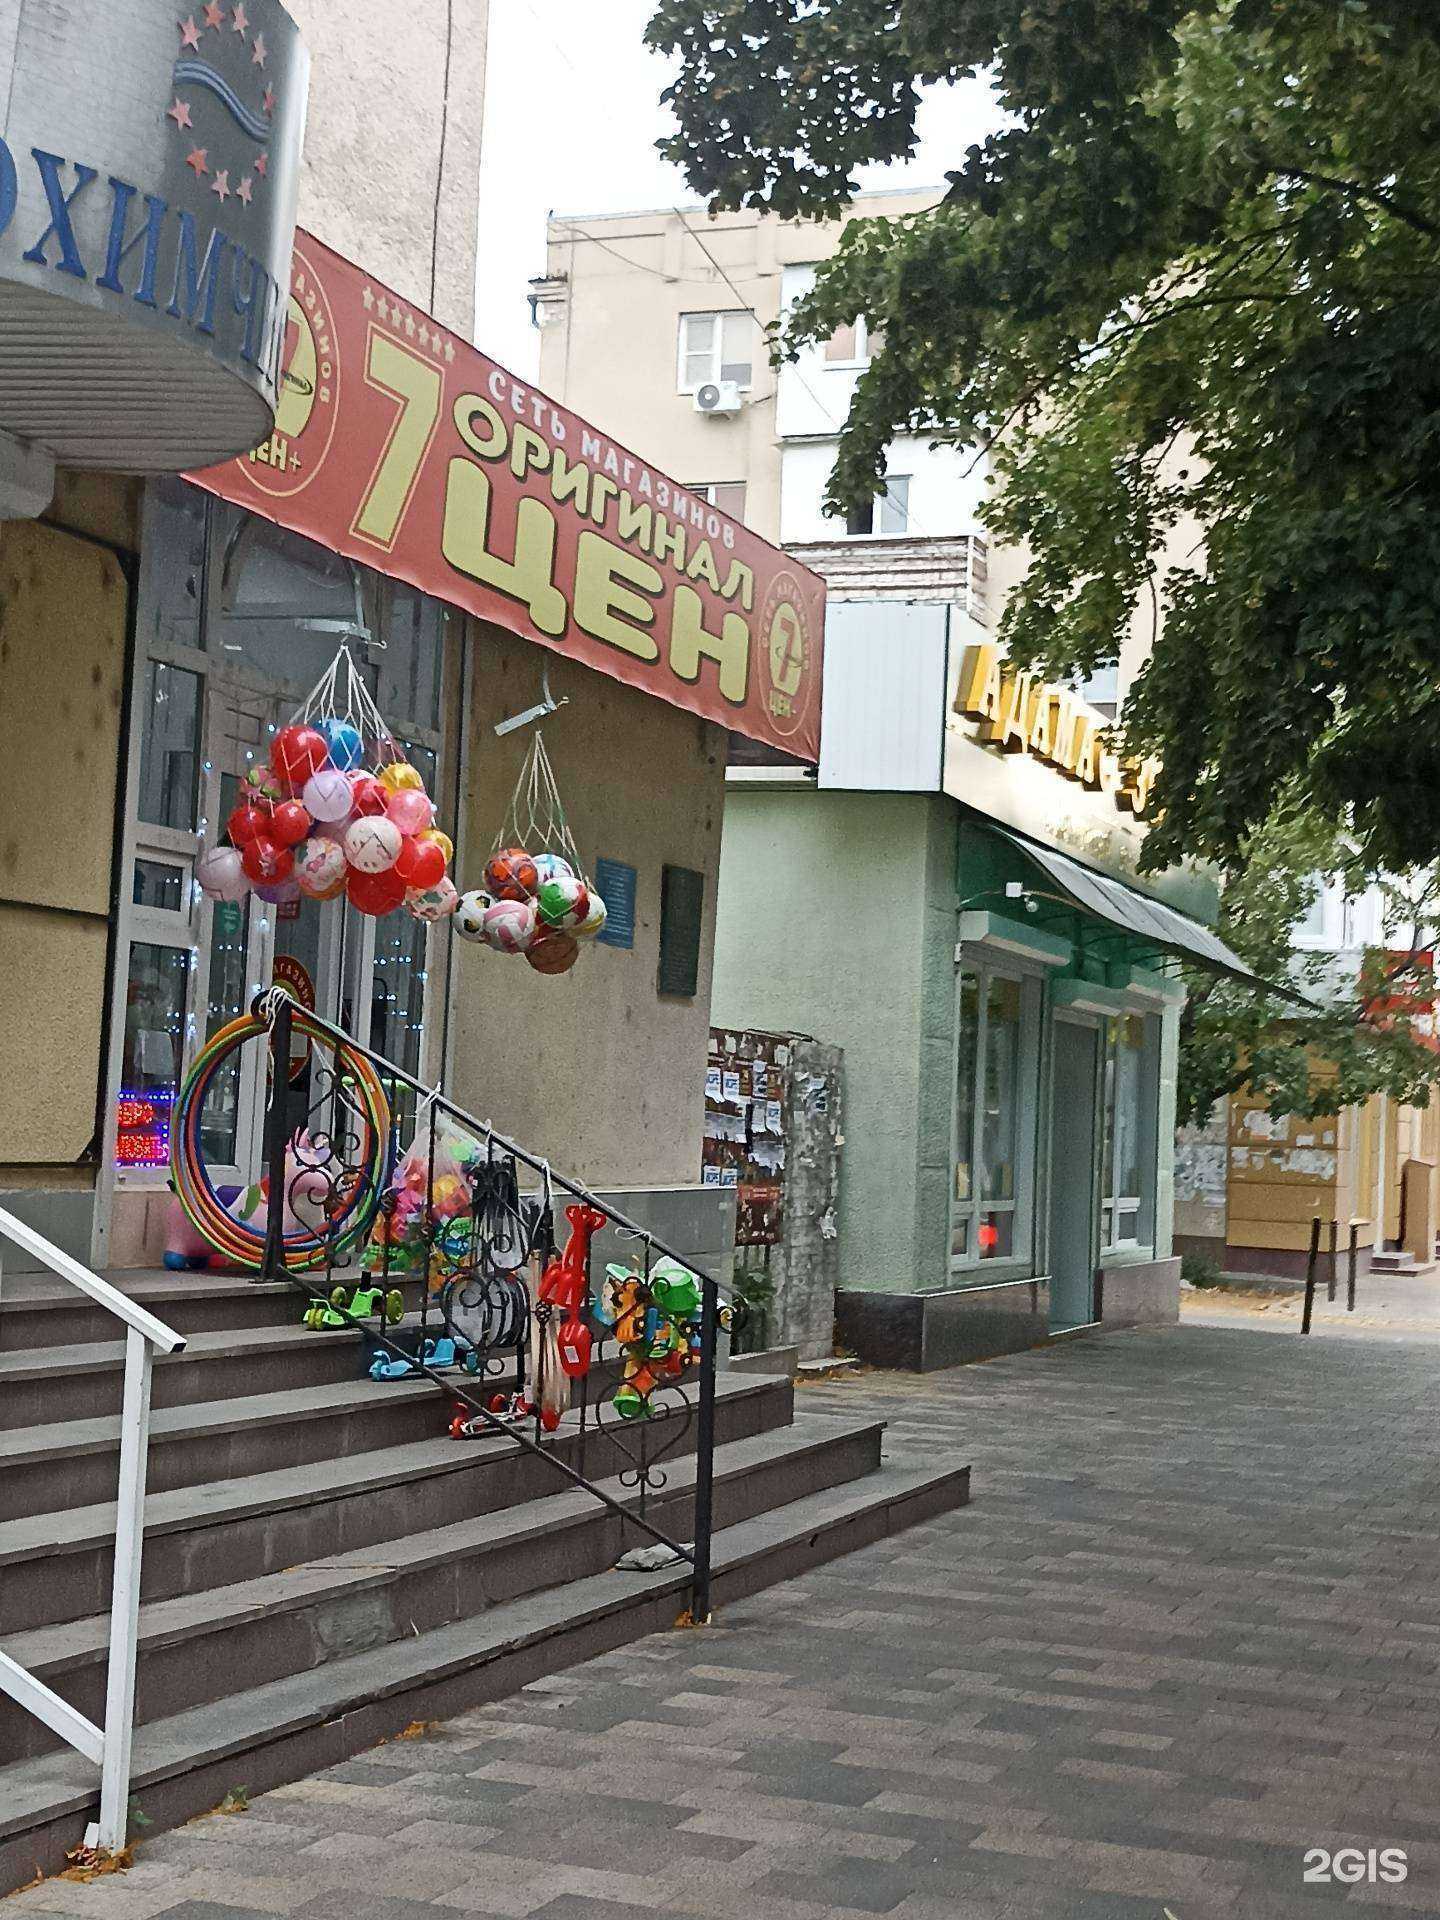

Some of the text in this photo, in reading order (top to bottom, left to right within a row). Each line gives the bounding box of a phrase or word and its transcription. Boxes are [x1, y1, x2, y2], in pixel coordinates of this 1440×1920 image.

[351, 323, 444, 552] 7
[453, 392, 755, 612] ОРИГИНАЛ
[488, 371, 735, 550] СЕТЬ МАГАЗИНОВ
[441, 456, 750, 706] ЦЕН
